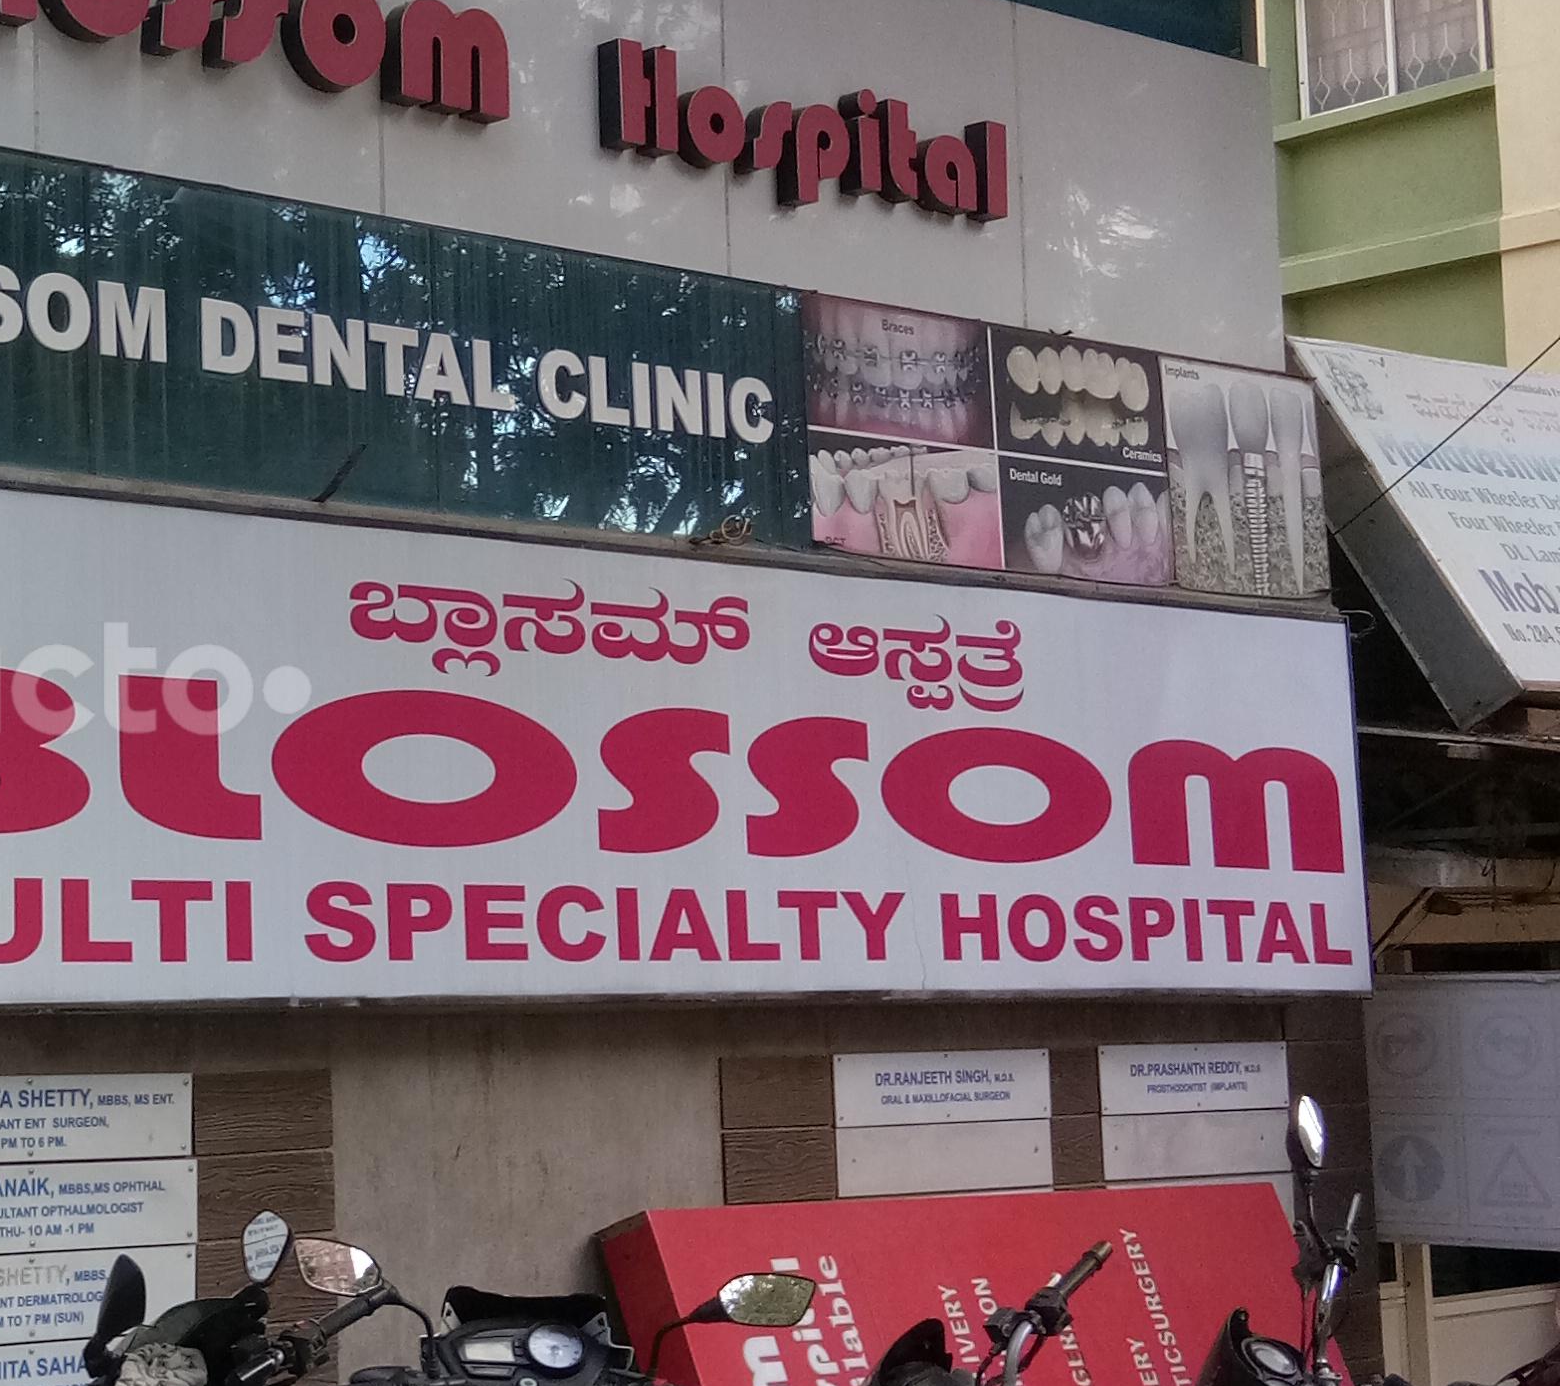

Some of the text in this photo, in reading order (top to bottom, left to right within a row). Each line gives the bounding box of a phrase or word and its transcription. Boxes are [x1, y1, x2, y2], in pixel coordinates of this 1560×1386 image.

[597, 35, 1008, 223] Hospital
[881, 317, 915, 337] Braces
[199, 299, 515, 414] DENTAL
[540, 347, 775, 445] CLINIC
[1164, 363, 1200, 381] Implants
[1122, 445, 1163, 465] Ceramics
[1008, 468, 1062, 488] Dental Gold
[1408, 481, 1541, 509] All Four Wheeler
[1448, 511, 1555, 537] Four Wheeler
[304, 881, 905, 965] SPECIALTY
[941, 893, 1352, 966] HOSPITAL
[18, 1089, 93, 1109] SHETTY,
[97, 1095, 130, 1107] MBBS,
[134, 1094, 149, 1105] MS
[152, 1094, 174, 1105] ENT.
[881, 1095, 903, 1105] ORAL
[974, 1091, 1010, 1101] SURGEON
[24, 1118, 45, 1129] ENT
[52, 1116, 109, 1128] SURGEON,
[1, 1137, 17, 1148] PM
[20, 1137, 35, 1148] TO
[38, 1137, 45, 1148] 6
[47, 1136, 66, 1147] PM.
[113, 1180, 165, 1193] OPHTHAL
[42, 1202, 144, 1216] OPTHALMOLOGIST
[28, 1222, 94, 1236] 10 AM PM
[18, 1291, 104, 1307] DERMATROLOG
[7, 1316, 22, 1327] TO
[25, 1315, 31, 1326] 7
[35, 1314, 50, 1325] PM
[54, 1312, 84, 1325] (SUN)
